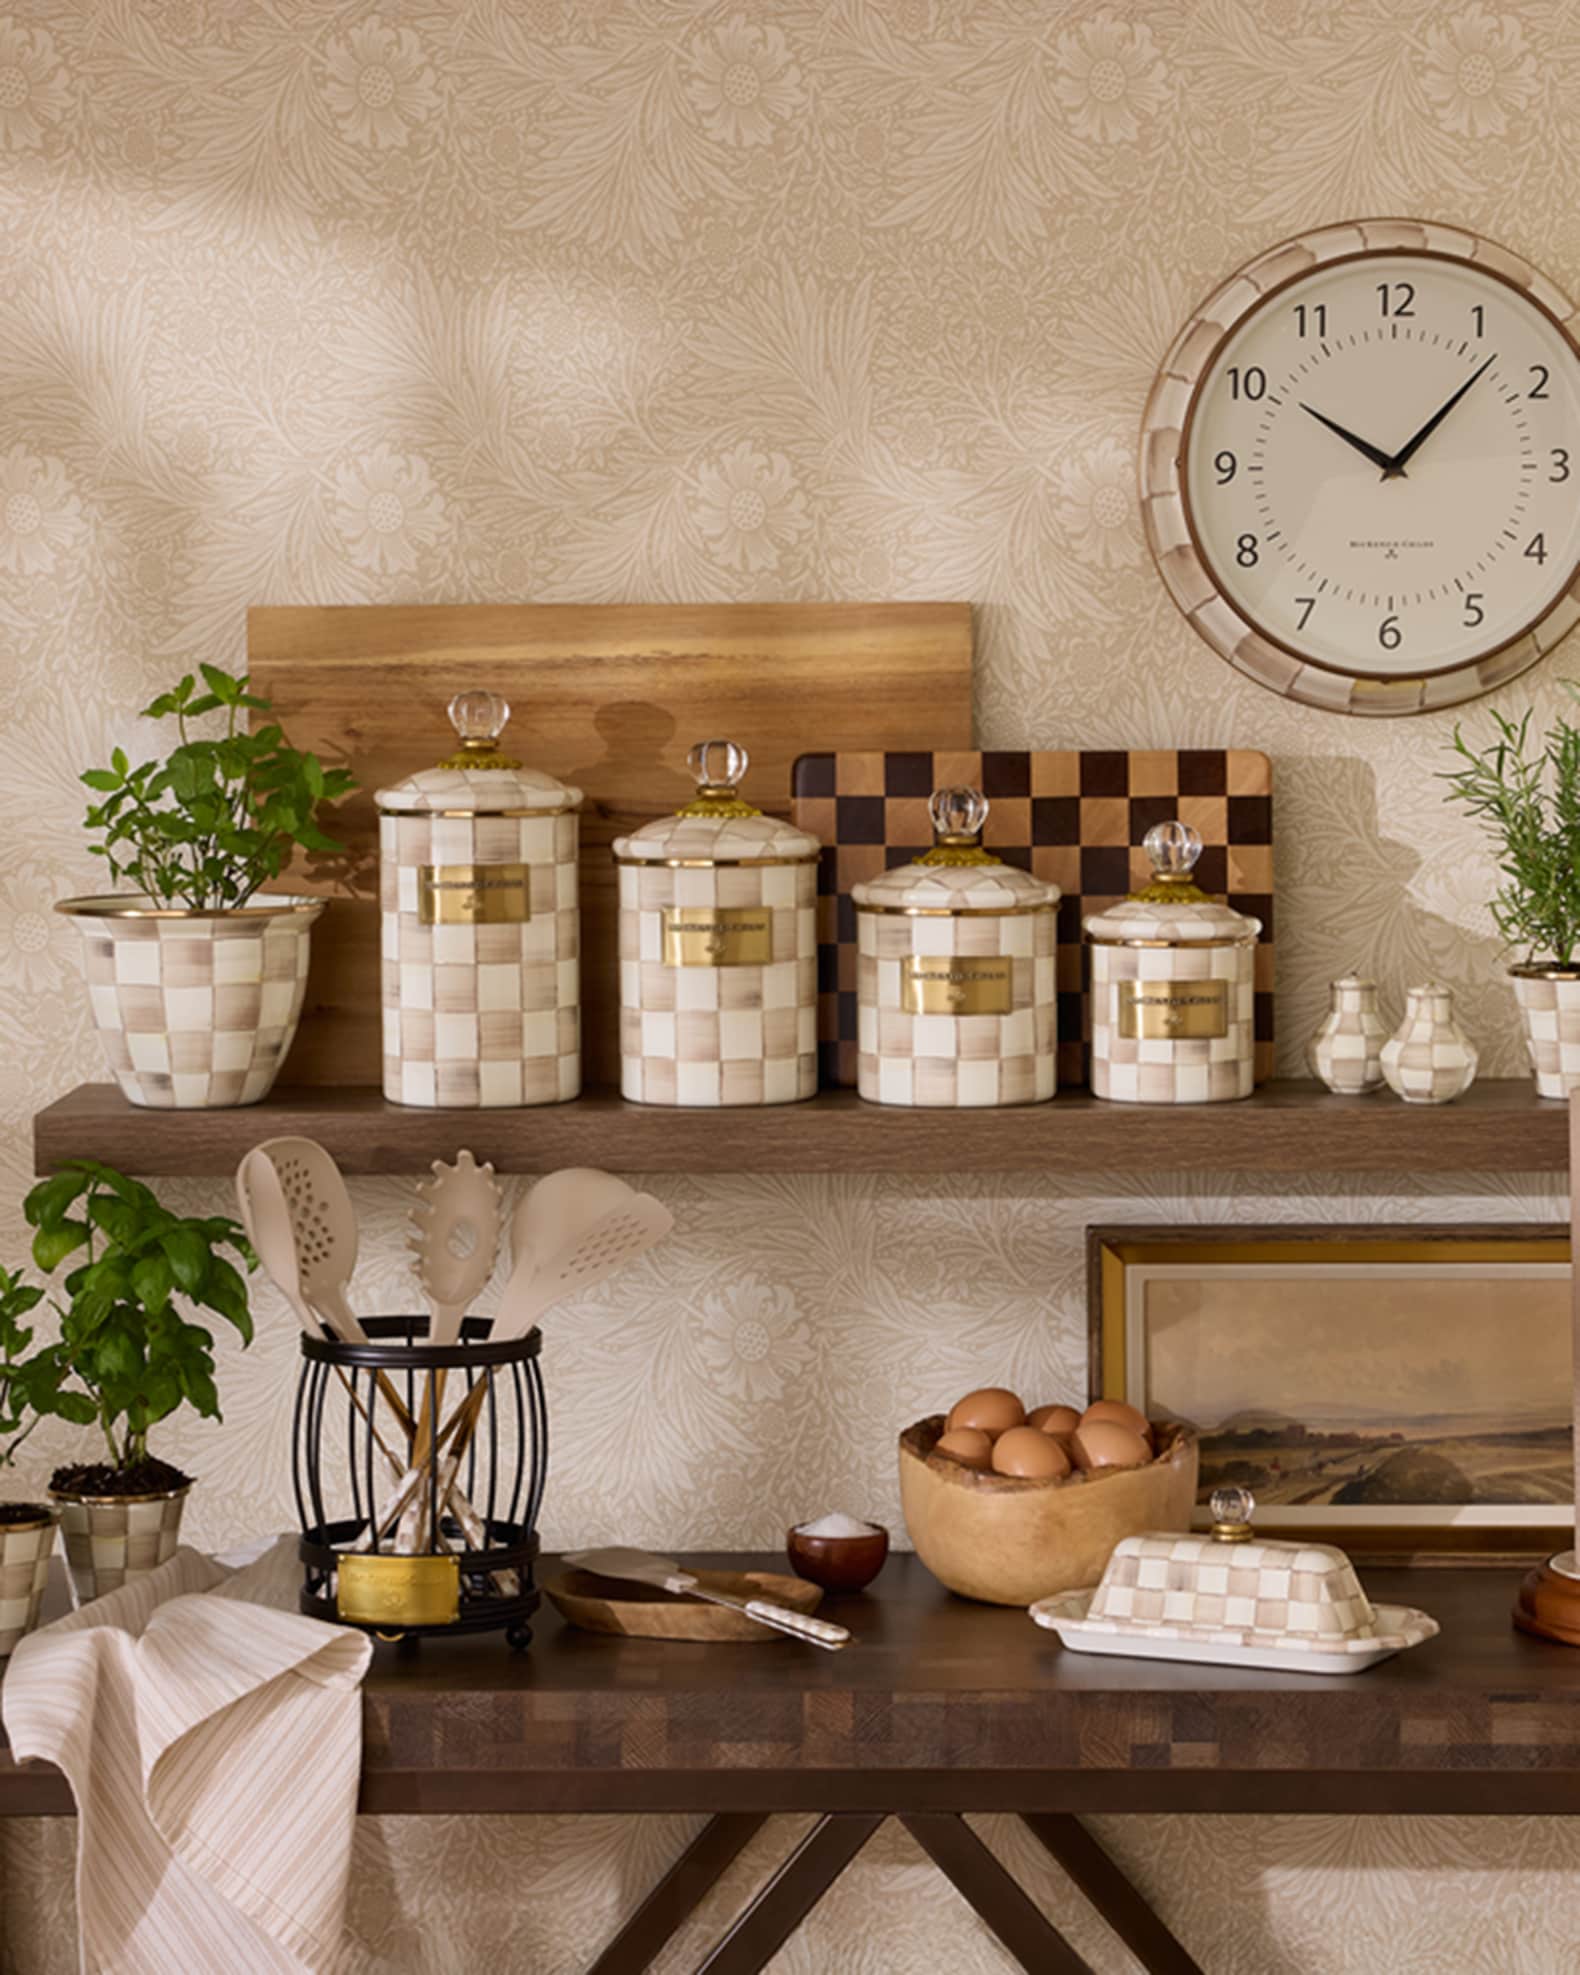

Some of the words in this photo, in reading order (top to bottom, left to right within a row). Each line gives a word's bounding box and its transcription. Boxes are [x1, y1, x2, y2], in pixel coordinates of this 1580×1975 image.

[1376, 283, 1416, 318] 12
[1292, 303, 1327, 338] 11
[1471, 304, 1484, 339] 1
[1226, 366, 1267, 402] 10
[1527, 364, 1550, 400] 2
[1213, 450, 1238, 486] 9
[1548, 448, 1571, 483] 3
[1235, 533, 1259, 569] 8
[1523, 532, 1549, 566] 4
[1294, 597, 1317, 632] 7
[1462, 594, 1485, 628] 5
[1378, 615, 1402, 651] 6
